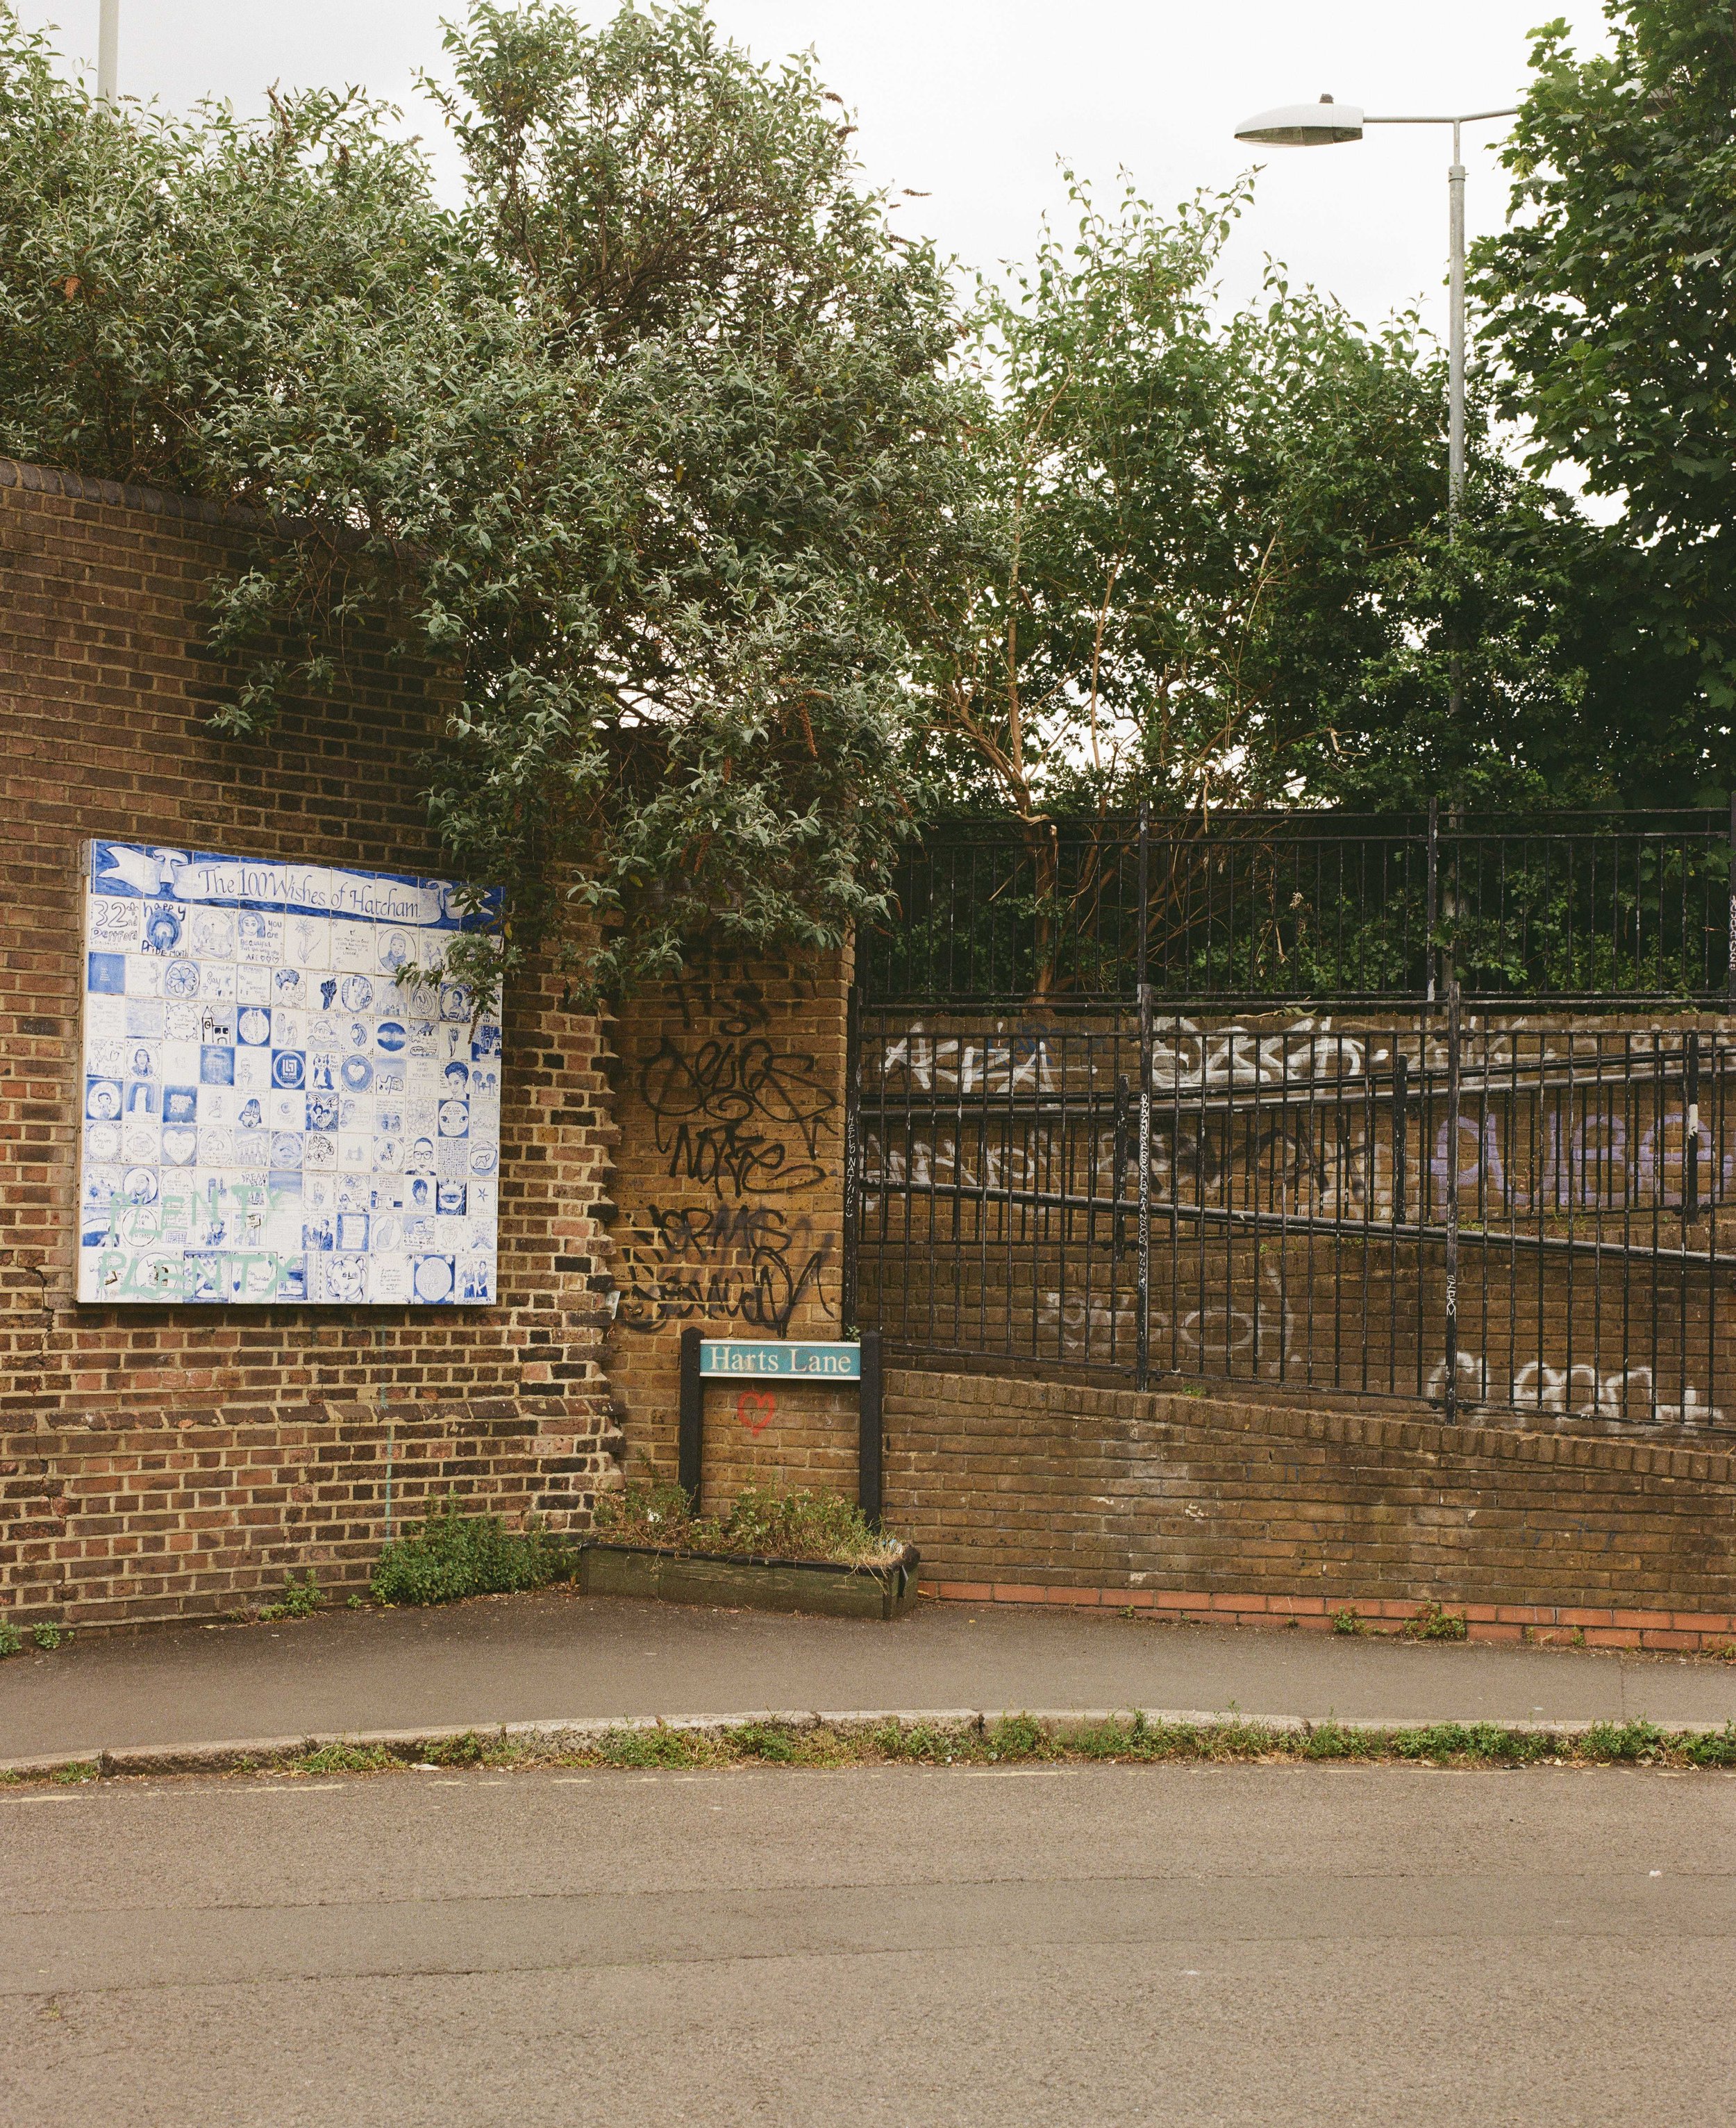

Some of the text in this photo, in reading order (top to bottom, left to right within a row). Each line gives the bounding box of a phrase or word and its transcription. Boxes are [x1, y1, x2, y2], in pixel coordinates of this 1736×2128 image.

[199, 866, 235, 894] The
[265, 872, 326, 906] Wishes
[331, 882, 348, 910] of
[848, 1111, 856, 1154] HELLO
[710, 1346, 851, 1373] Harts Lane
